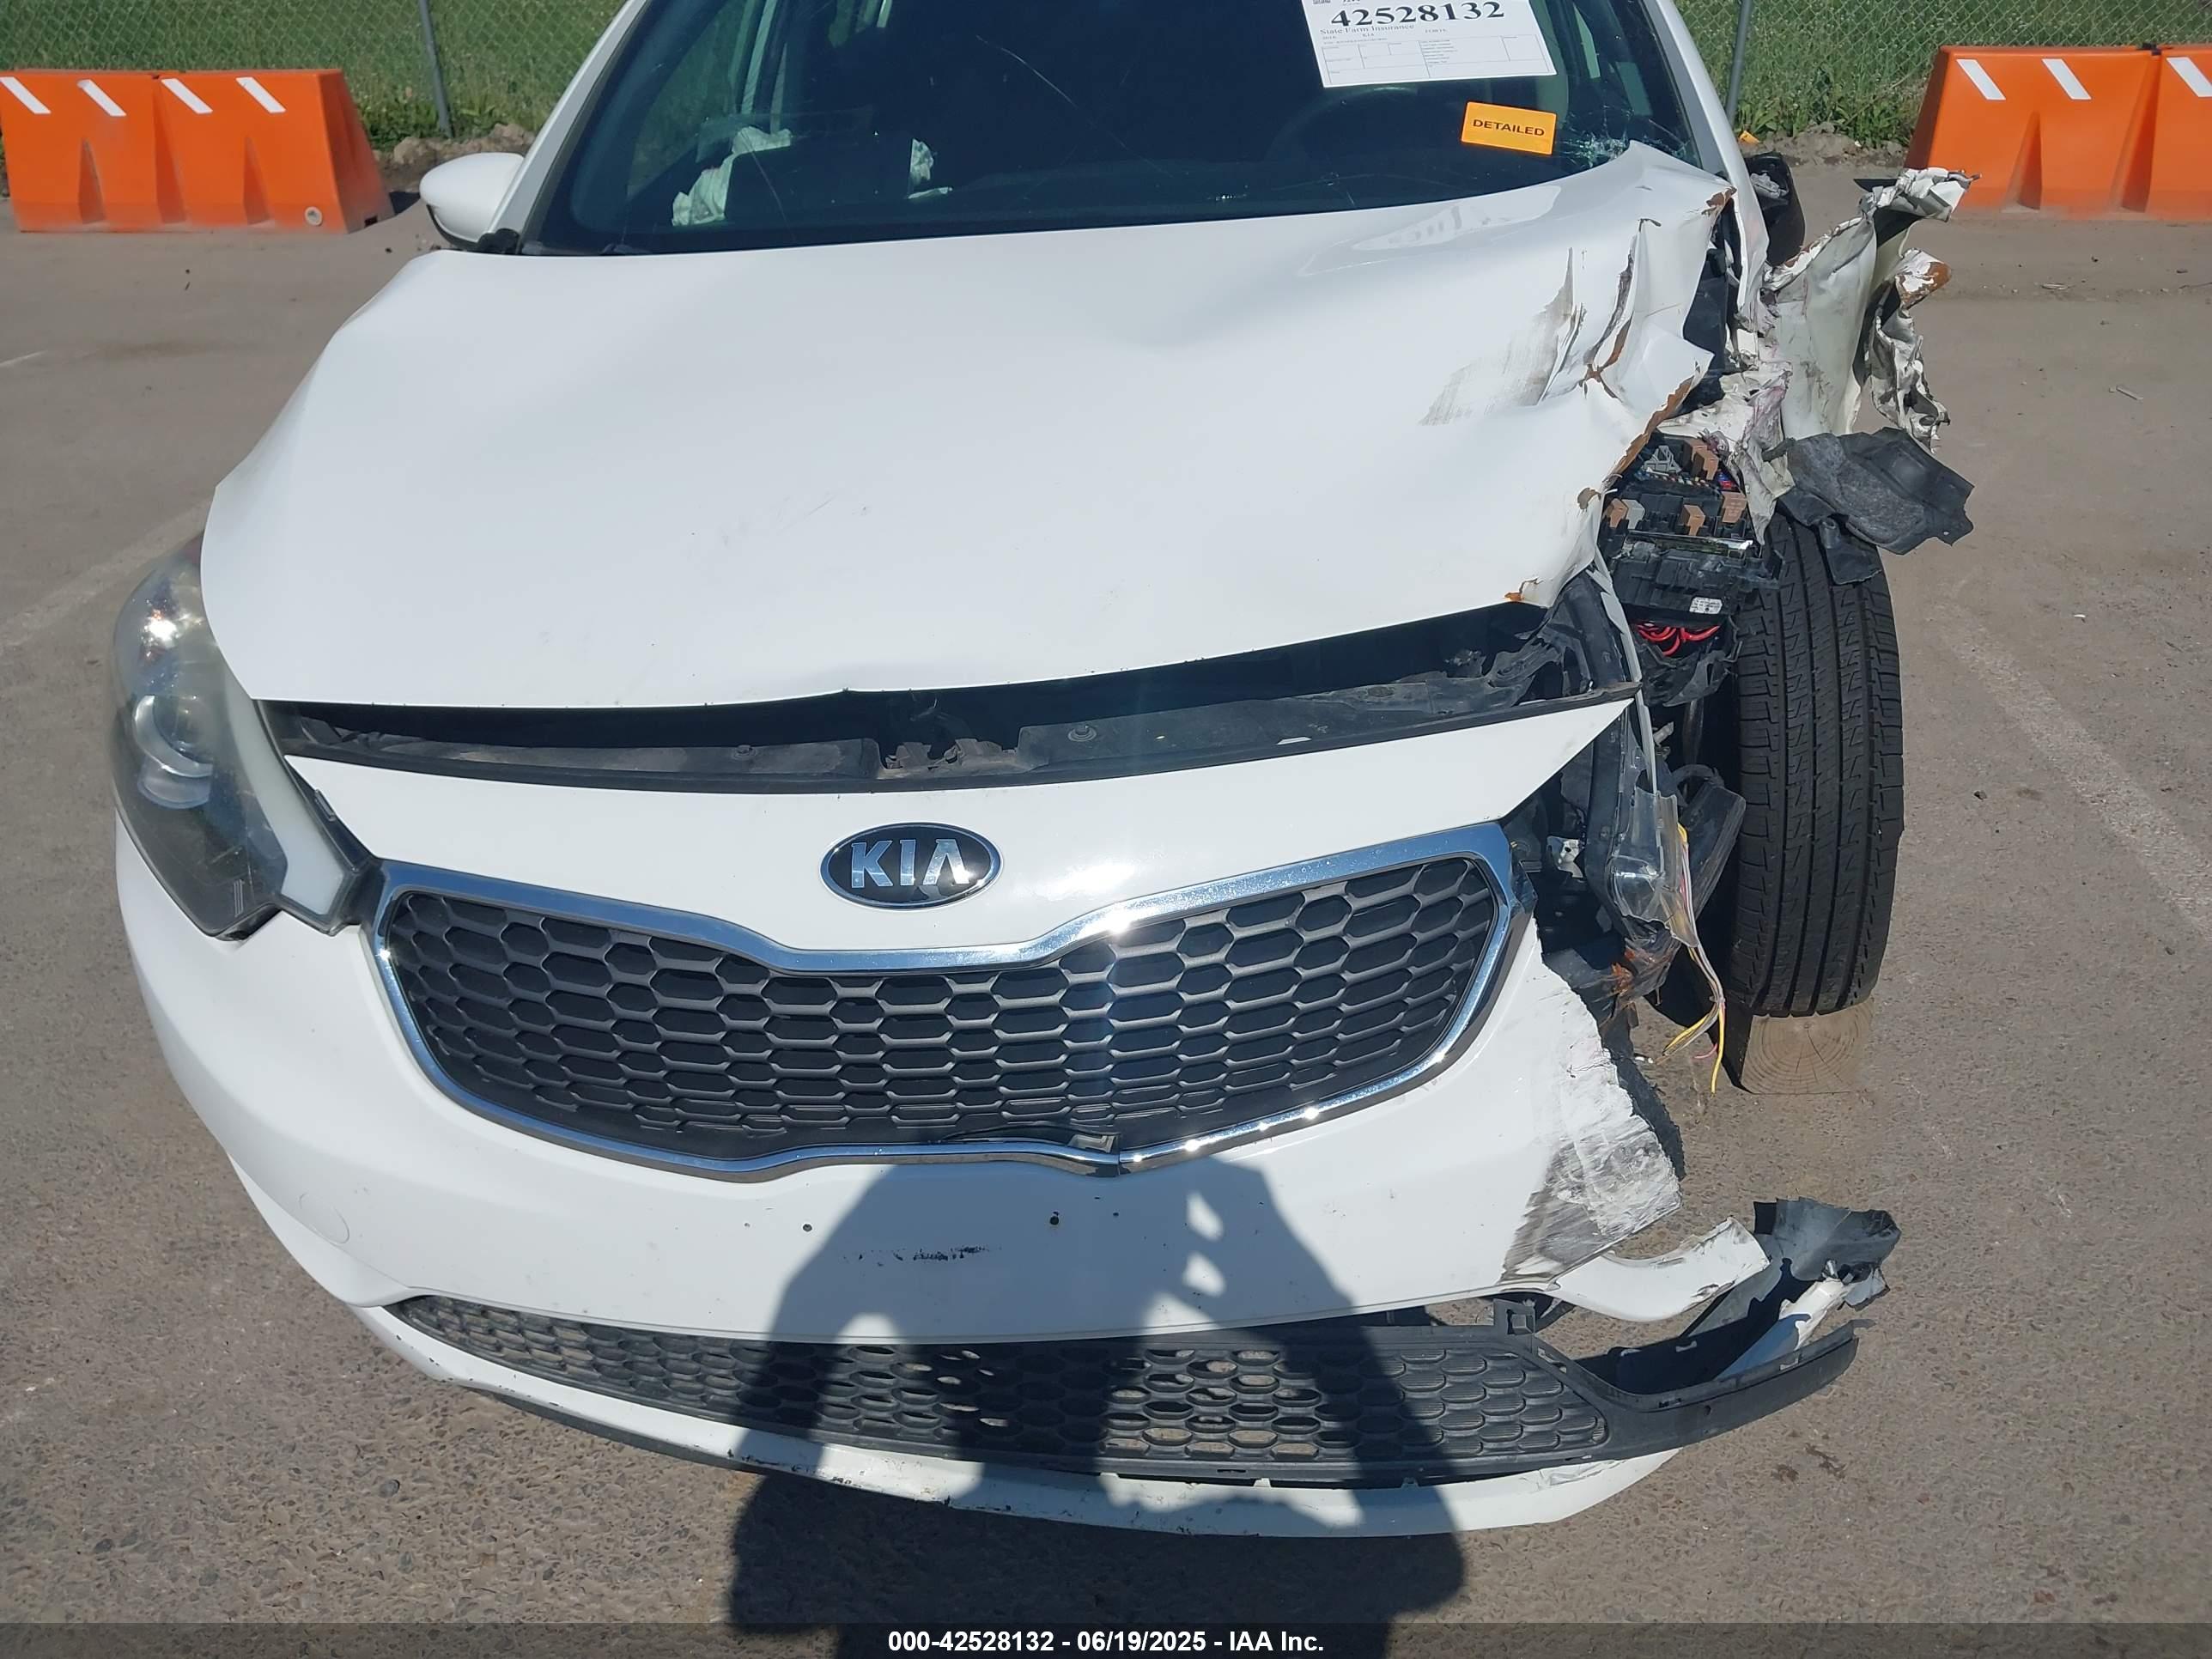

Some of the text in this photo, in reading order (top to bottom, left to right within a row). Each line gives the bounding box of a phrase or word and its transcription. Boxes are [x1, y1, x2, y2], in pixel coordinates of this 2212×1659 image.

[1331, 2, 1504, 27] 42528132
[1473, 118, 1545, 137] DETAILED
[851, 838, 970, 889] KIA
